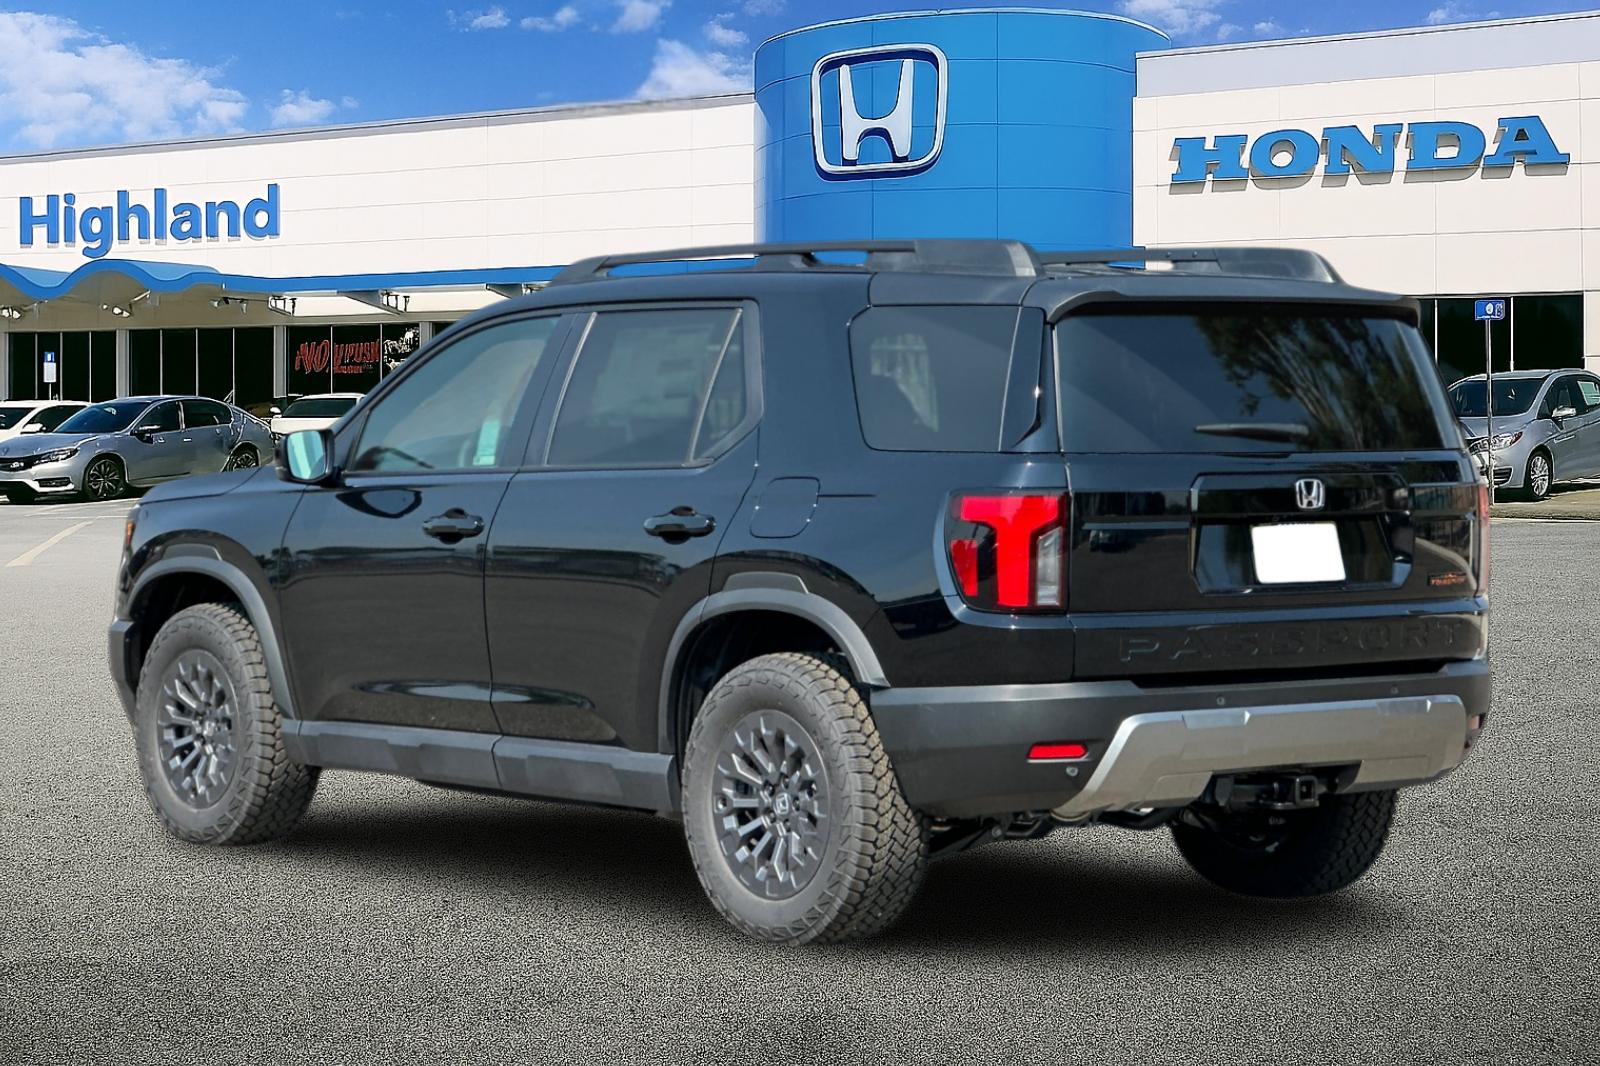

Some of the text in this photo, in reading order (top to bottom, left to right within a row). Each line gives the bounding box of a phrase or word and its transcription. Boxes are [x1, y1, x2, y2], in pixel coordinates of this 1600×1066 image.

[1171, 115, 1570, 186] HONDA
[19, 183, 280, 258] Highland
[1120, 619, 1461, 662] PASSPORT
